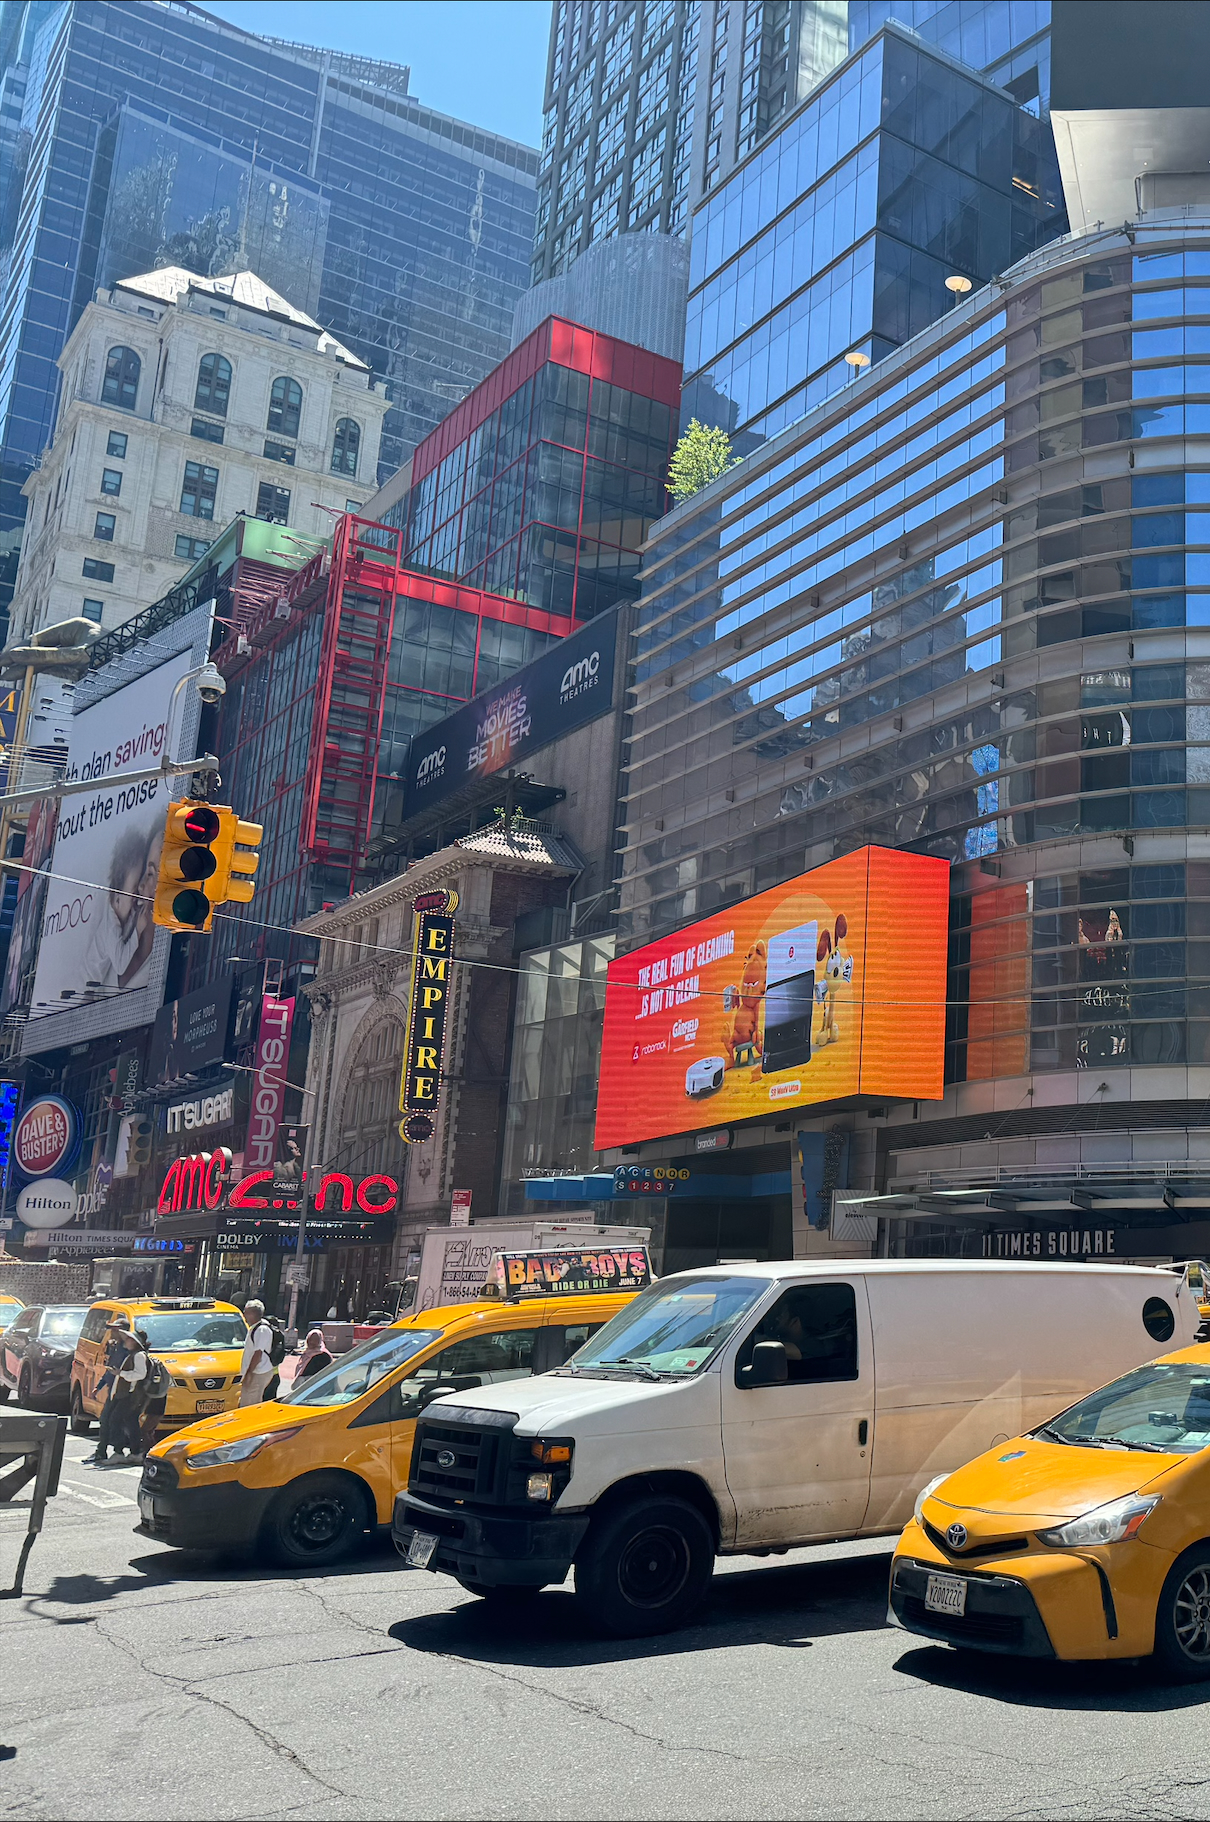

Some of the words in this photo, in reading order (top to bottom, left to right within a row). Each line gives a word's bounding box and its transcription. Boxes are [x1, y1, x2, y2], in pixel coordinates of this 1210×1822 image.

[560, 651, 600, 693] amc
[486, 700, 498, 716] WE
[499, 685, 522, 708] MAKE
[559, 675, 599, 705] THEATRES
[476, 695, 527, 743] MOVIES
[467, 714, 532, 771] BETTER
[82, 751, 112, 782] plan
[417, 745, 446, 779] amc
[416, 767, 445, 790] THEATRES
[89, 794, 113, 826] the
[116, 779, 158, 815] noise
[638, 966, 651, 991] THE
[651, 960, 668, 988] REAL
[670, 953, 685, 982] FUN
[685, 948, 696, 973] OF
[697, 930, 735, 968] CLEANING
[189, 1007, 201, 1025] LOVE
[202, 1003, 216, 1020] YOUR
[413, 928, 447, 1100] EMPIRE
[649, 989, 665, 1016] NOT
[664, 985, 675, 1011] TO
[641, 1040, 667, 1056] roborock
[672, 1018, 699, 1038] GARFIELD
[248, 1003, 289, 1168] IT'SUGAR
[167, 1089, 234, 1134] IT'SUGAR
[21, 1114, 54, 1144] DAVE
[55, 1112, 65, 1132] &
[21, 1131, 65, 1161] BUSTER'S
[25, 1197, 71, 1210] Hilton
[48, 1232, 83, 1243] Hilton
[87, 1235, 111, 1243] TIMES
[112, 1235, 135, 1244] SQUA
[217, 1234, 263, 1245] DOLBY
[982, 1234, 992, 1257] 11
[997, 1232, 1042, 1256] TIMES
[1048, 1230, 1116, 1255] SQUARE
[124, 1265, 153, 1273] IMAX
[507, 1258, 561, 1285] BAD
[580, 1252, 647, 1278] BOYS
[552, 1280, 575, 1291] RIDE
[577, 1279, 590, 1290] OR
[593, 1278, 609, 1288] DIE
[618, 1278, 636, 1286] JUNE
[637, 1277, 642, 1285] 7
